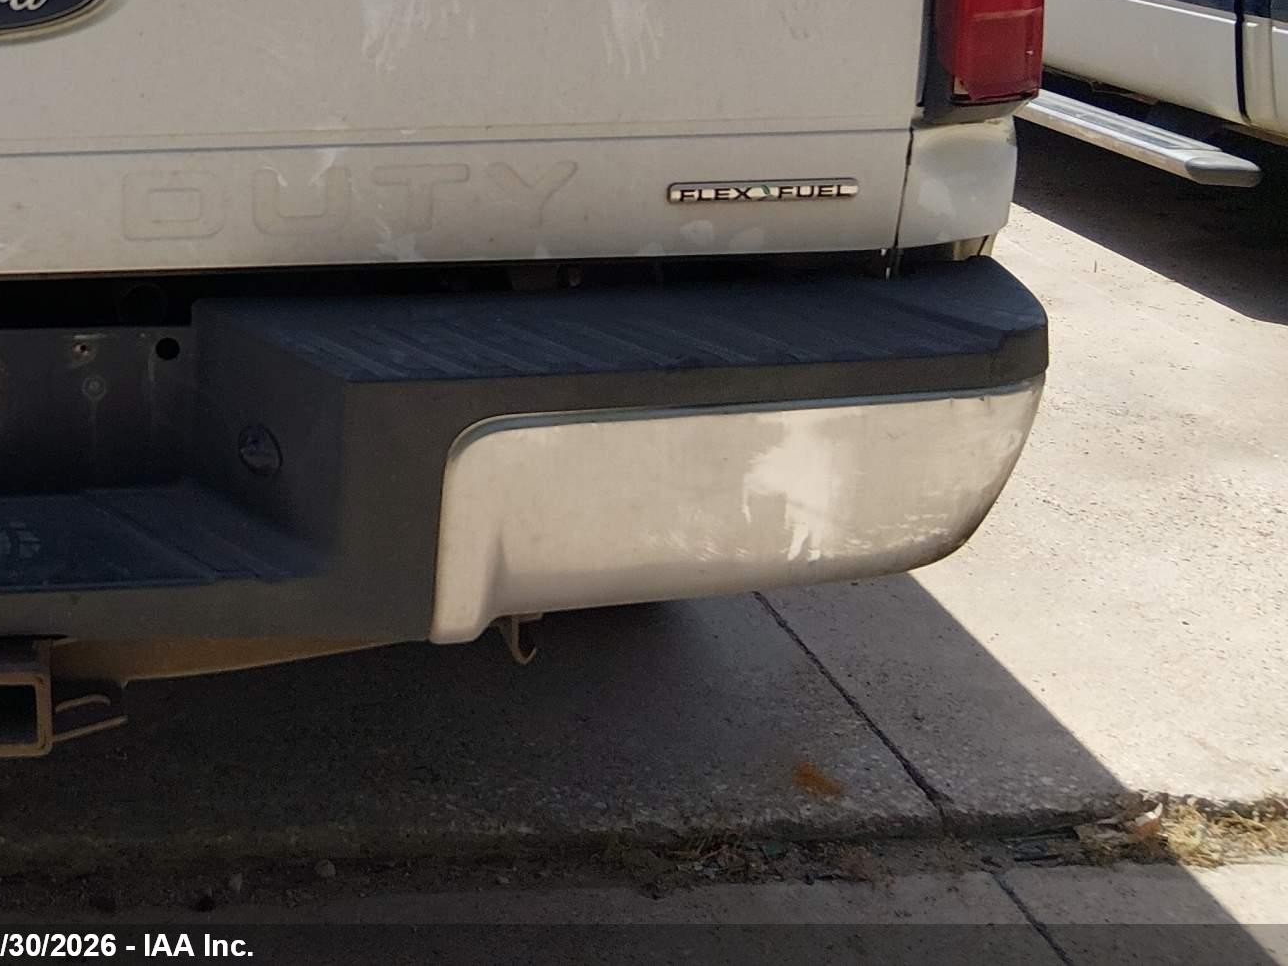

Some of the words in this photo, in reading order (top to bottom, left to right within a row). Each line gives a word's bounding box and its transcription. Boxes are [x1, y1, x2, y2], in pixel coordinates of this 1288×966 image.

[120, 160, 580, 241] DUTY
[679, 186, 753, 202] FLEX
[777, 184, 851, 200] FUEL
